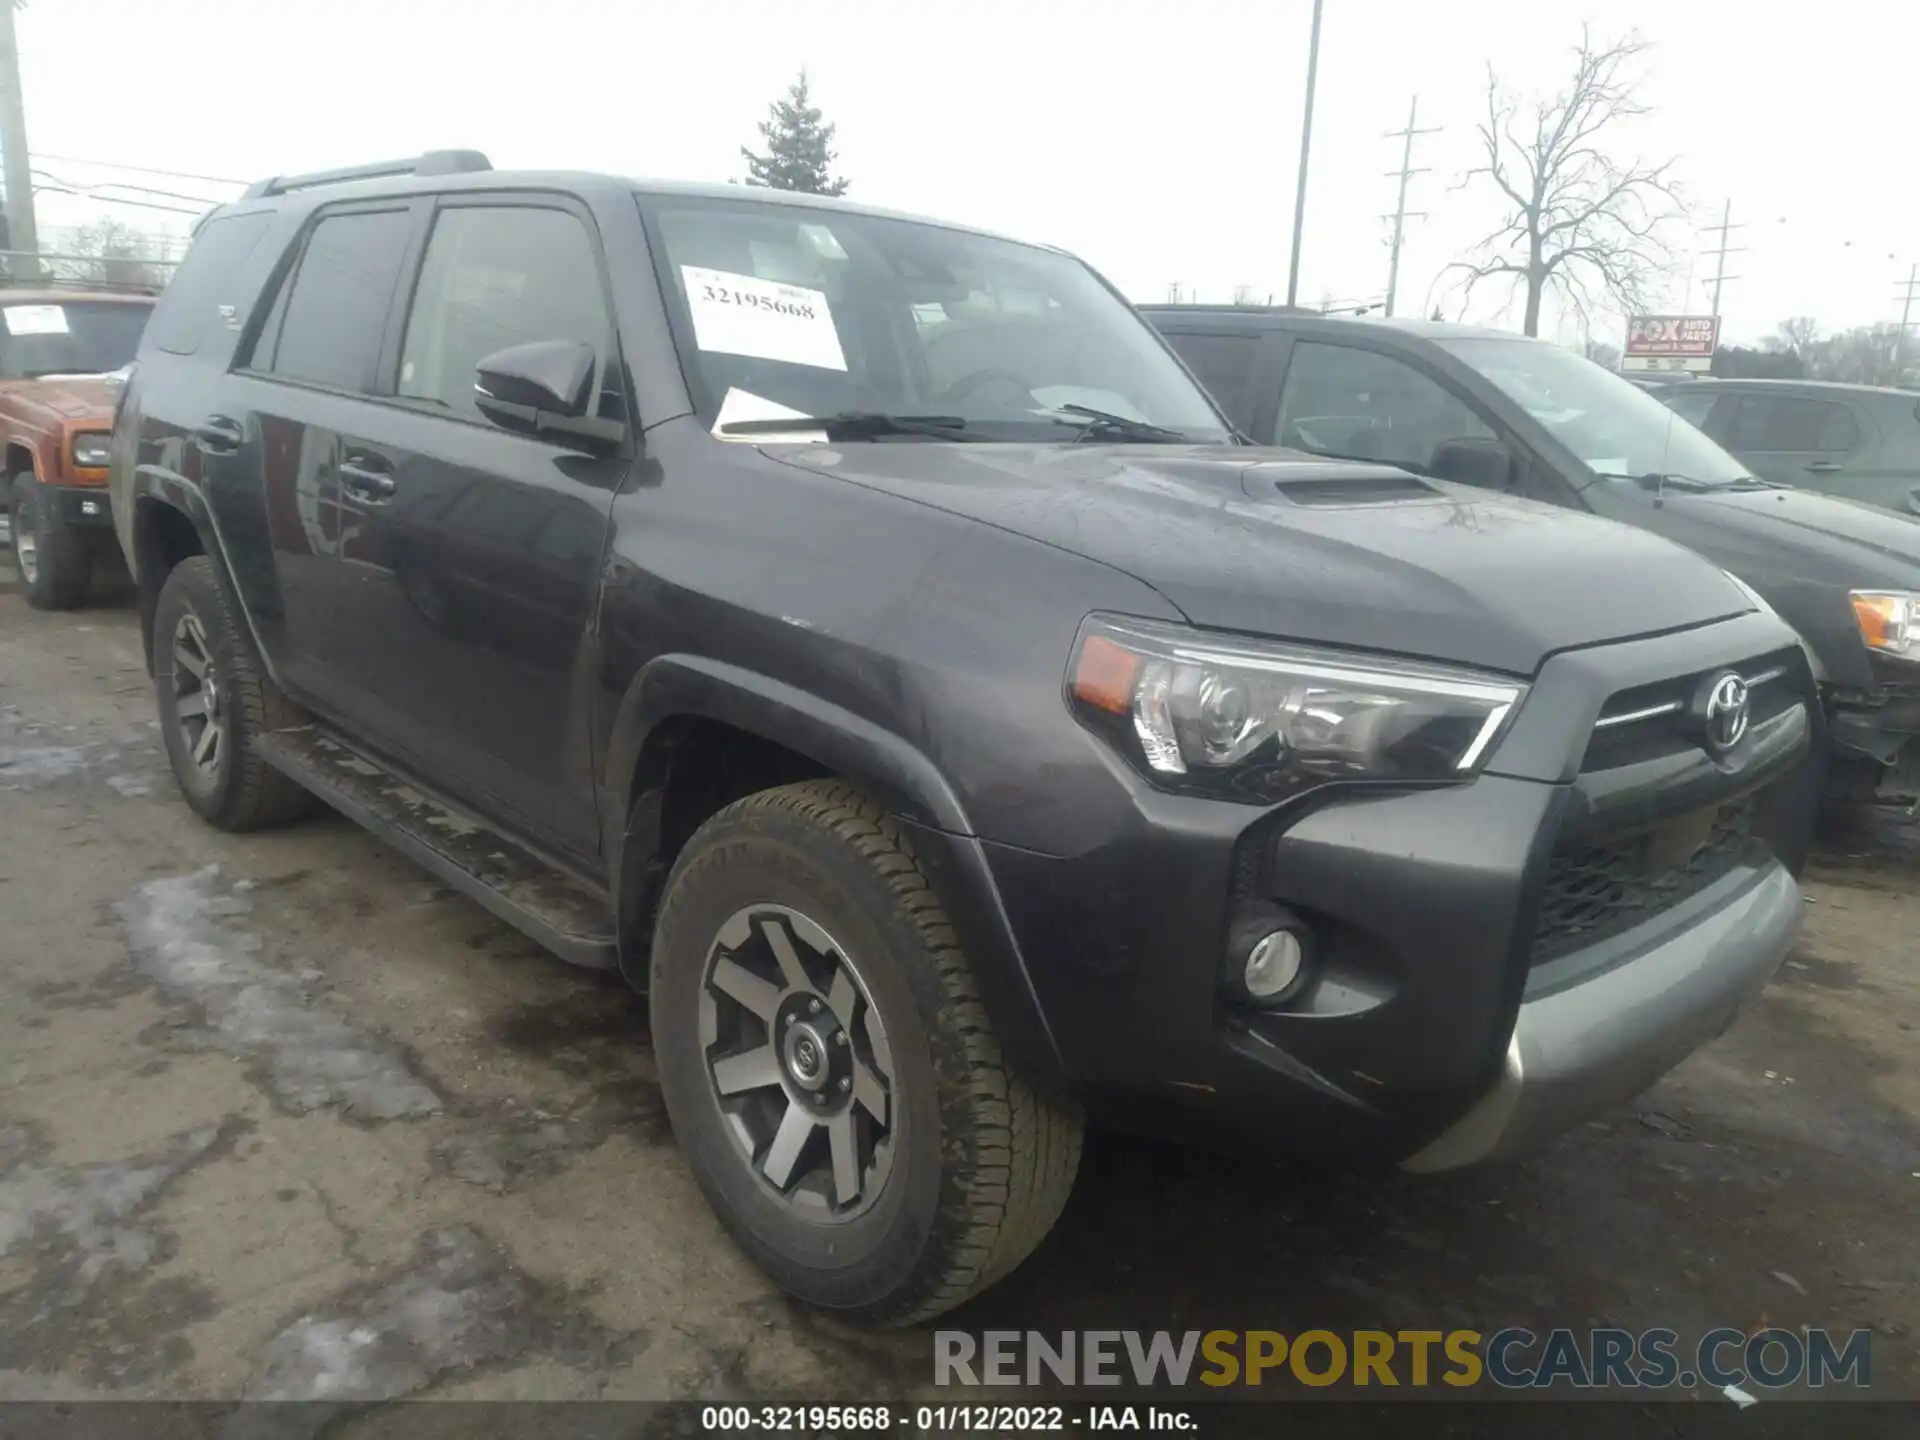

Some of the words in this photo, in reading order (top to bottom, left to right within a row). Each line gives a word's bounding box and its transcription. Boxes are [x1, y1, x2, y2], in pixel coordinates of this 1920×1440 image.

[703, 285, 815, 320] 32195668
[1631, 320, 1680, 341] FOX
[1683, 319, 1711, 330] AUTO
[1681, 330, 1713, 341] PARTS
